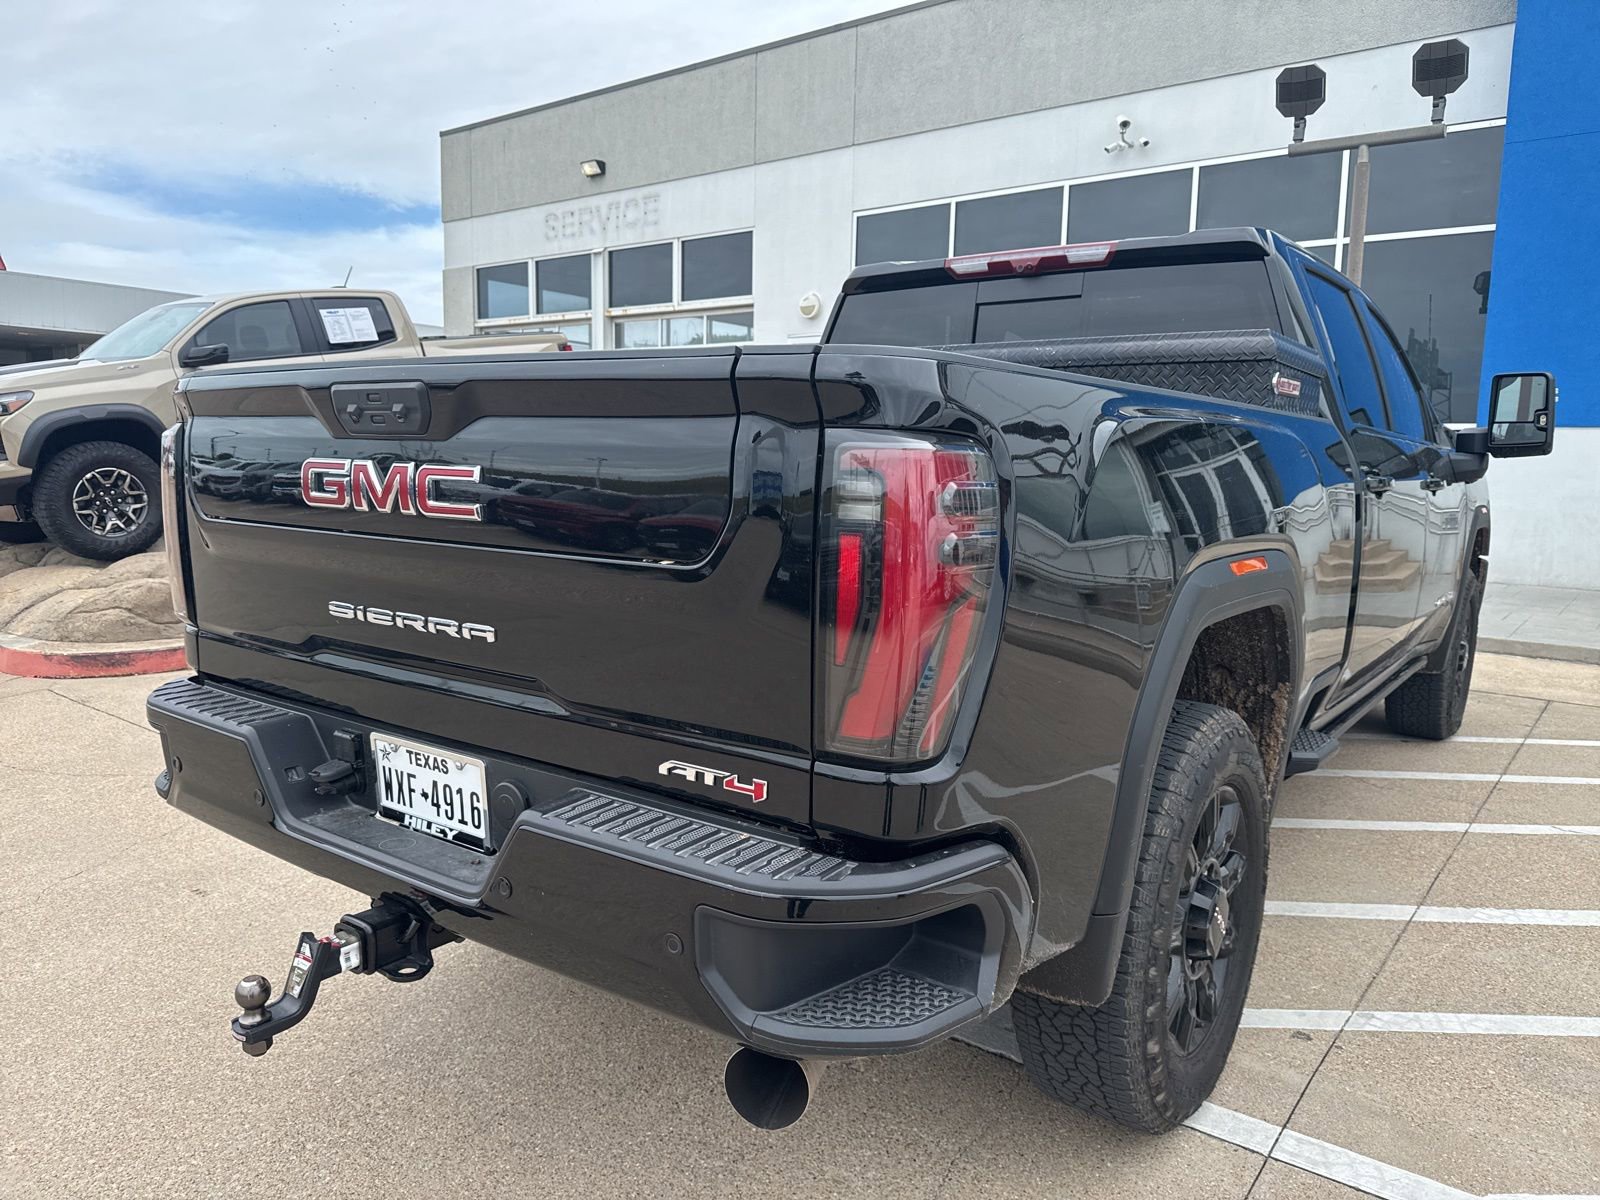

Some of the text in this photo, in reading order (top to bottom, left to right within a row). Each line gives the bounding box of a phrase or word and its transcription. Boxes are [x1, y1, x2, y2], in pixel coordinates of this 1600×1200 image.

[544, 194, 661, 241] SERVICE
[301, 457, 483, 522] GMC
[328, 600, 497, 643] SIERRA
[405, 749, 450, 775] TEXAS
[658, 759, 768, 804] AT4
[382, 765, 482, 830] WXF 4916
[403, 813, 460, 841] HILEY
